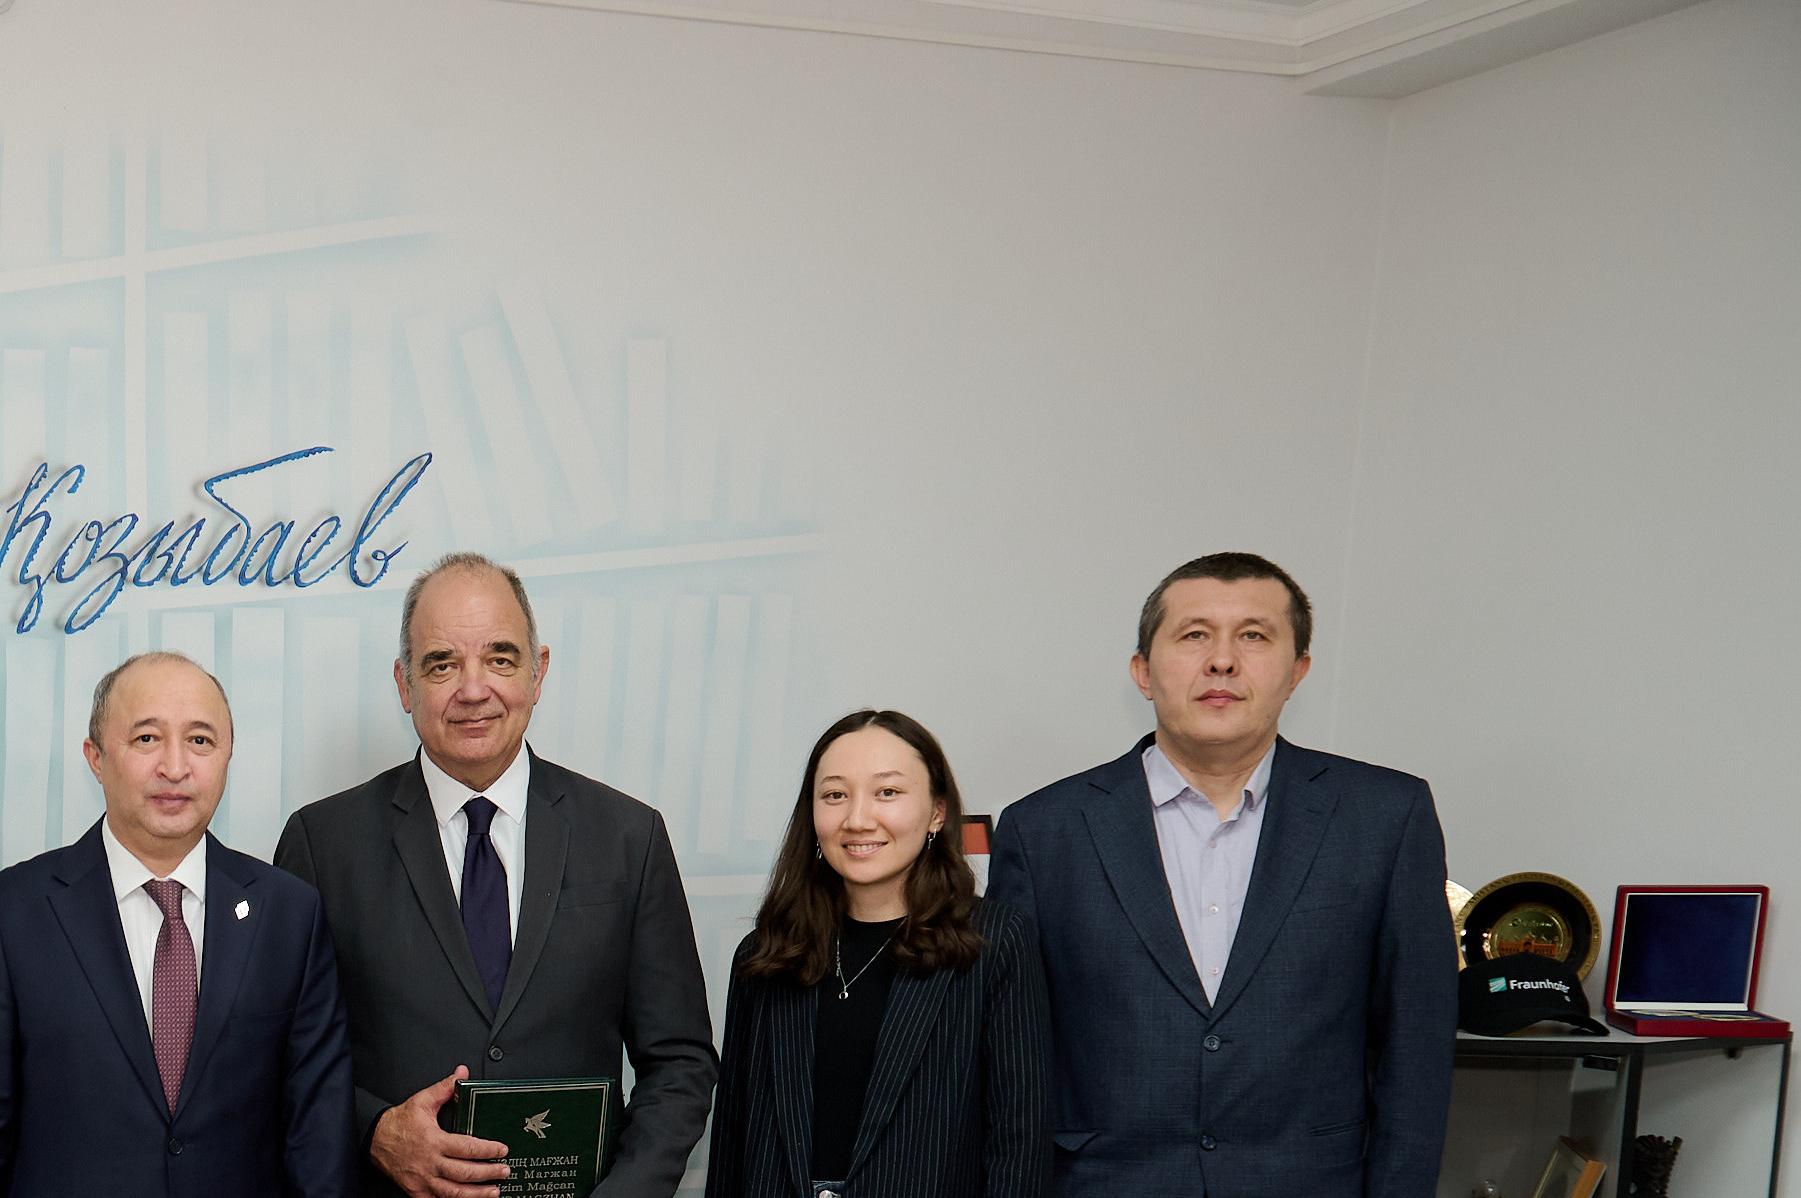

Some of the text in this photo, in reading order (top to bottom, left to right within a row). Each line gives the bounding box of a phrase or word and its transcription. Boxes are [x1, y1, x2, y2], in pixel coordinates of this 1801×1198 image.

[1509, 978, 1571, 994] Fraunhofer
[488, 1157, 528, 1168] ЗДІҢ
[524, 1169, 577, 1180] Магжан
[498, 1181, 576, 1193] izim Mağcan
